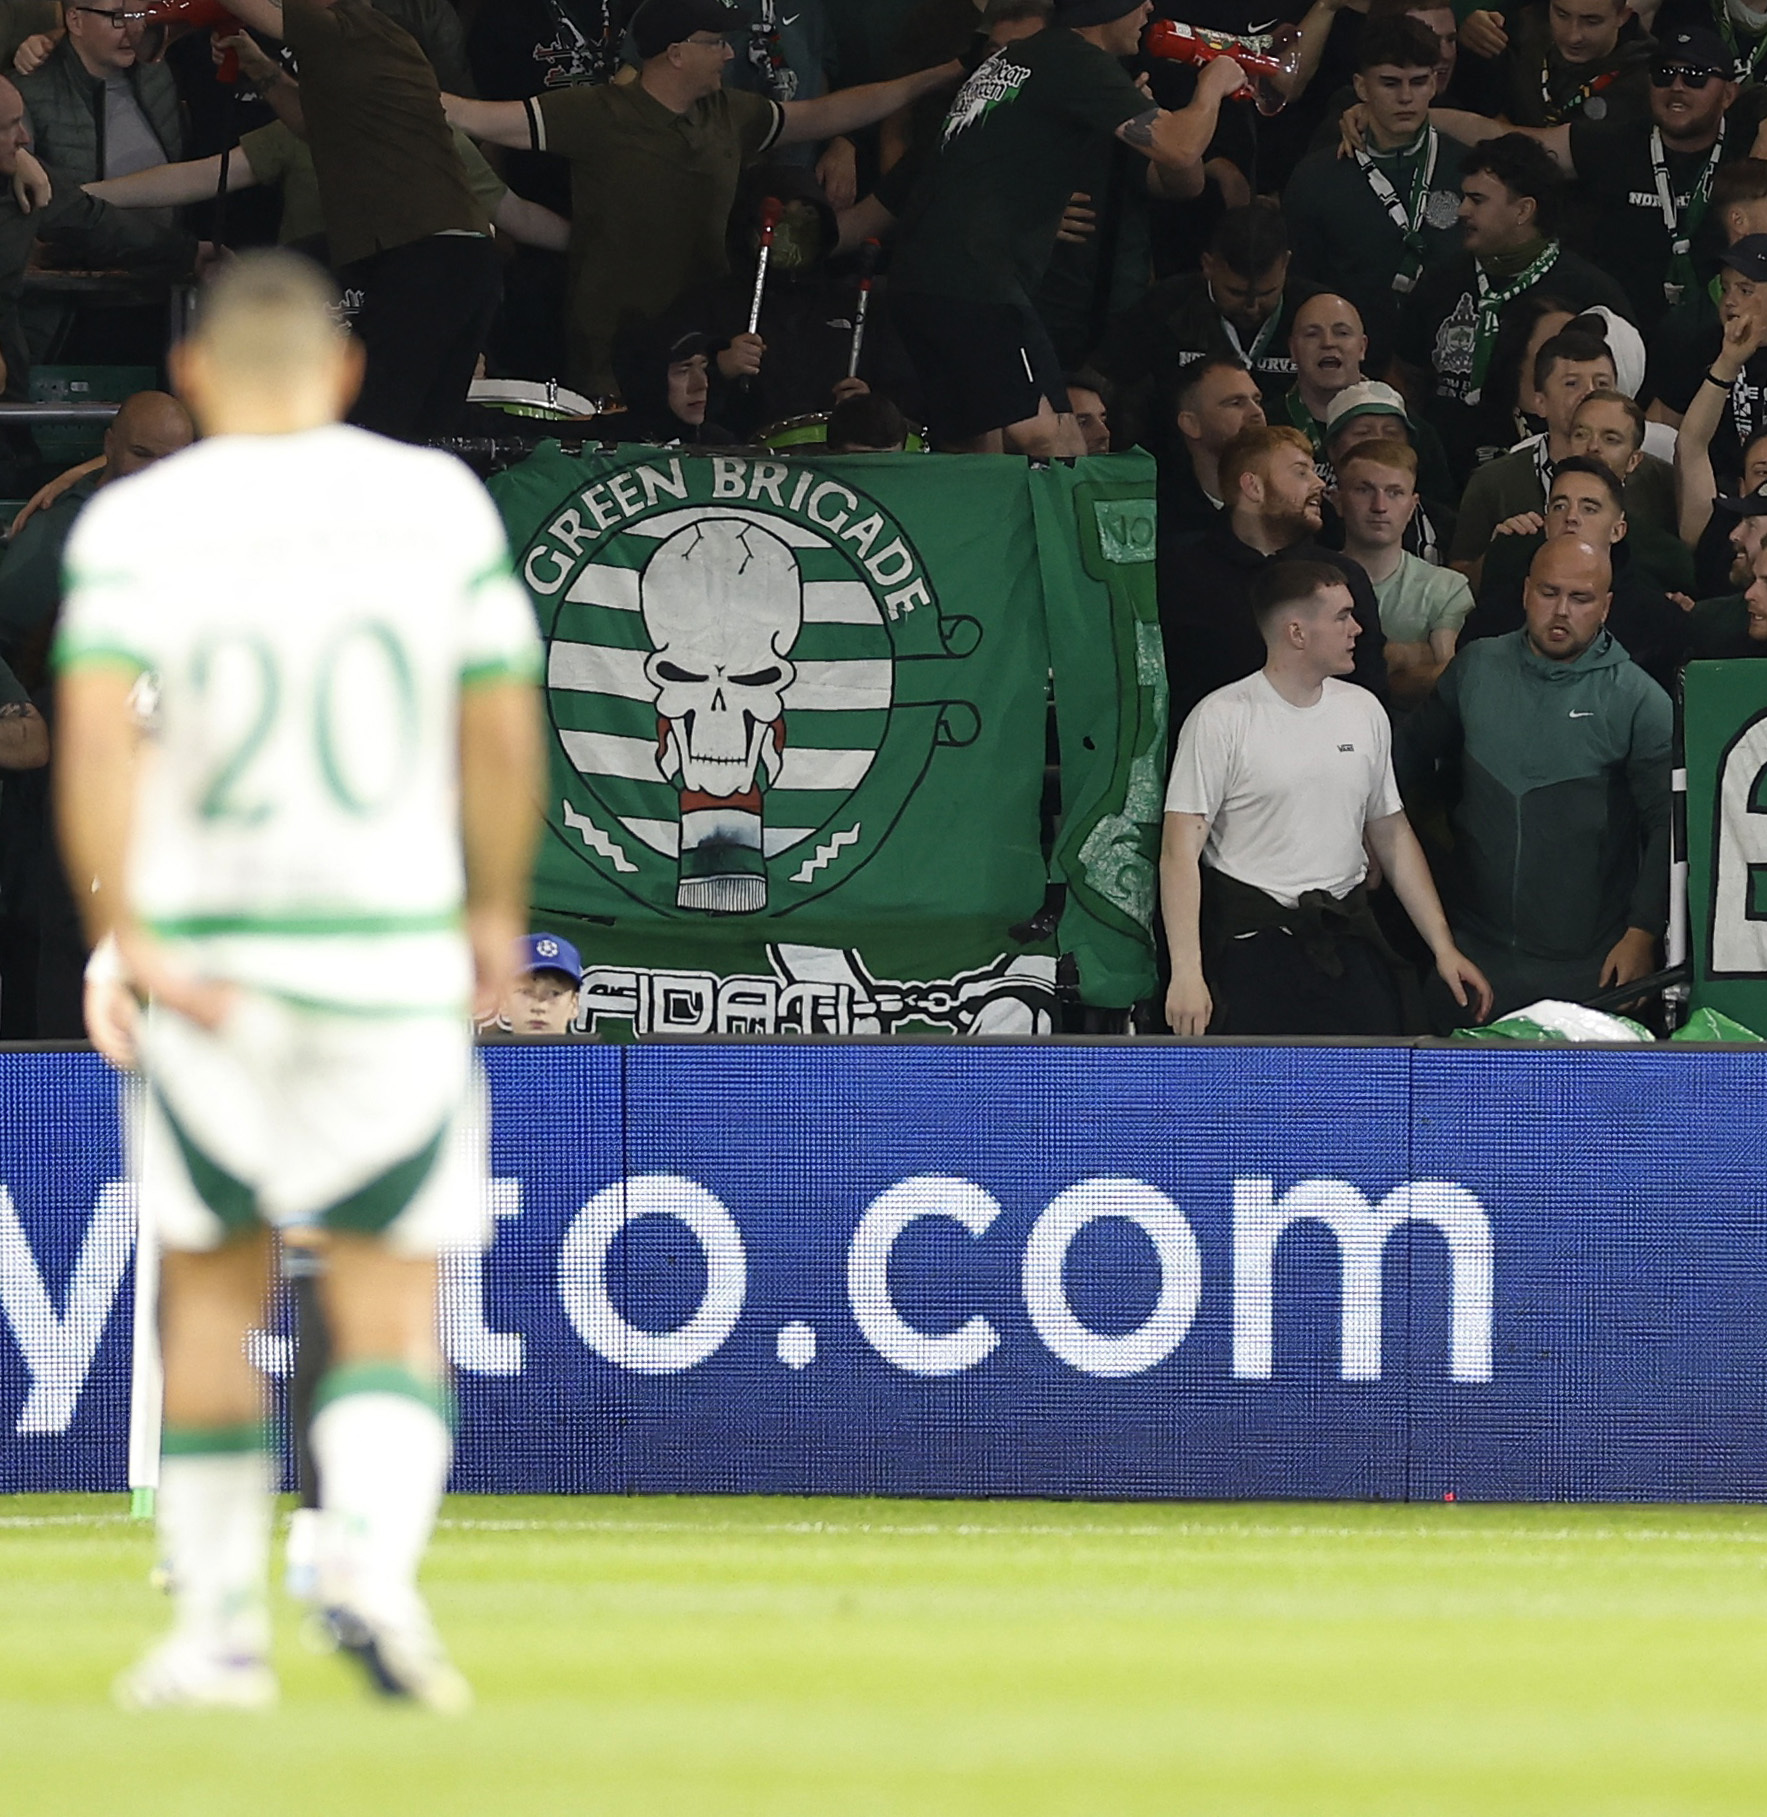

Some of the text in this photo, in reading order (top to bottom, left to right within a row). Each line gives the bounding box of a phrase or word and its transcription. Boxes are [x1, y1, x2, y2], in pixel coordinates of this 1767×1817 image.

[523, 456, 933, 625] GREEN BRIGADE
[187, 619, 420, 822] 20
